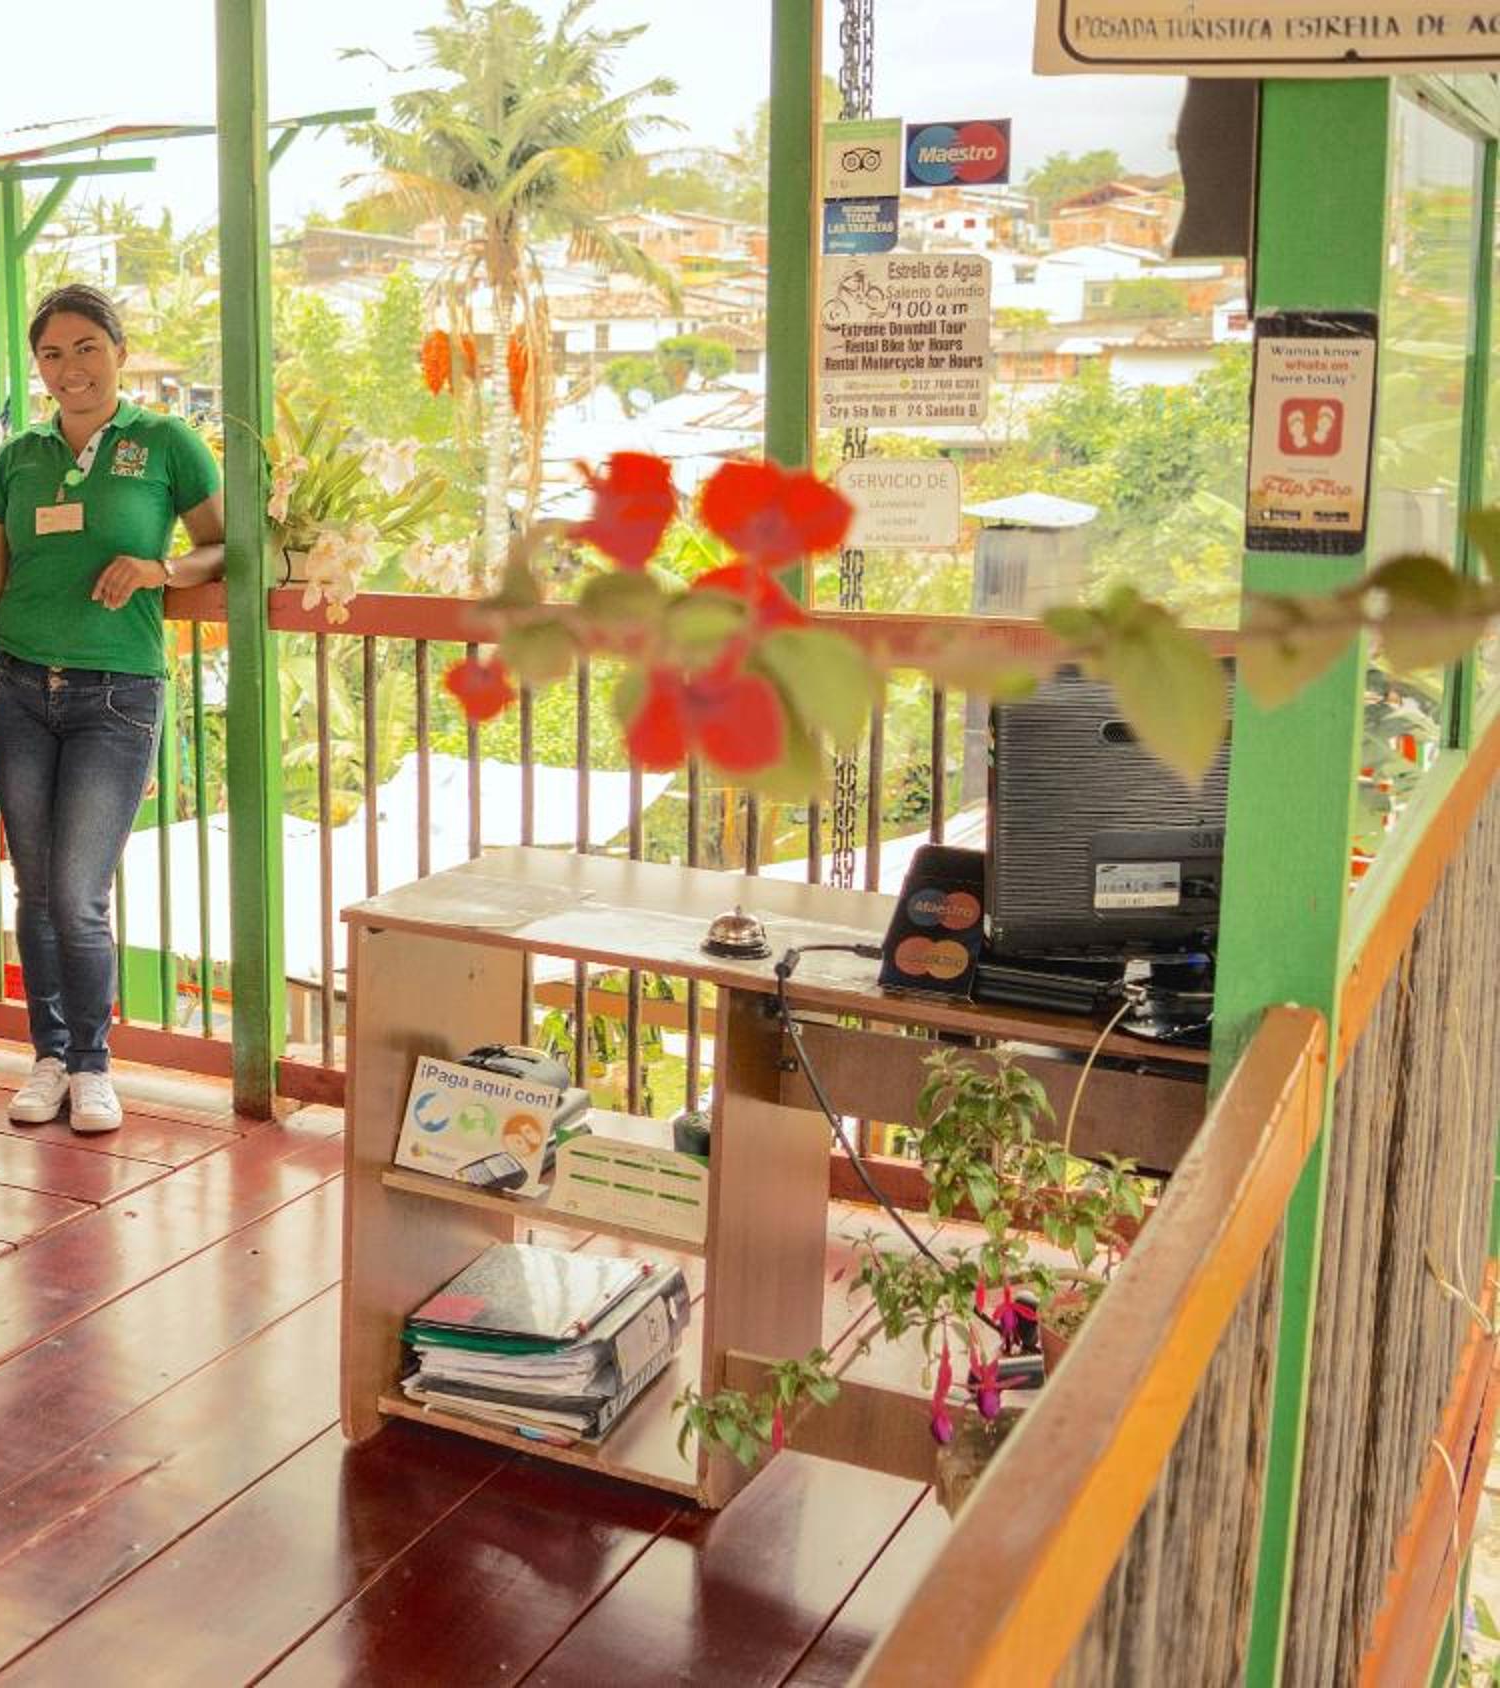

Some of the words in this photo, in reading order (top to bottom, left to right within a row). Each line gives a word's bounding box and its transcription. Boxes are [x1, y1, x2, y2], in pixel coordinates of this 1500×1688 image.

[1075, 15, 1158, 41] POSADA
[1286, 13, 1400, 39] ESTRELLA
[1417, 15, 1447, 37] DE
[917, 144, 998, 164] Maestro
[887, 261, 931, 280] Estrella
[933, 261, 949, 279] de
[951, 260, 983, 282] Agua
[841, 322, 887, 337] Extreme
[889, 320, 937, 337] Downhill
[940, 319, 967, 335] Tour
[845, 339, 879, 353] Rental
[881, 338, 905, 353] Bike
[908, 338, 925, 352] for
[929, 337, 963, 352] Hours
[1272, 346, 1320, 357] Wanna
[1323, 346, 1361, 357] know
[825, 357, 859, 371] Rental
[861, 355, 925, 371] Motorcycle
[928, 354, 946, 369] for
[949, 354, 983, 368] Hours
[1331, 361, 1349, 370] on
[1271, 373, 1303, 384] here
[848, 473, 921, 489] SERVICIO
[927, 472, 949, 489] DE
[514, 1089, 554, 1108] con!
